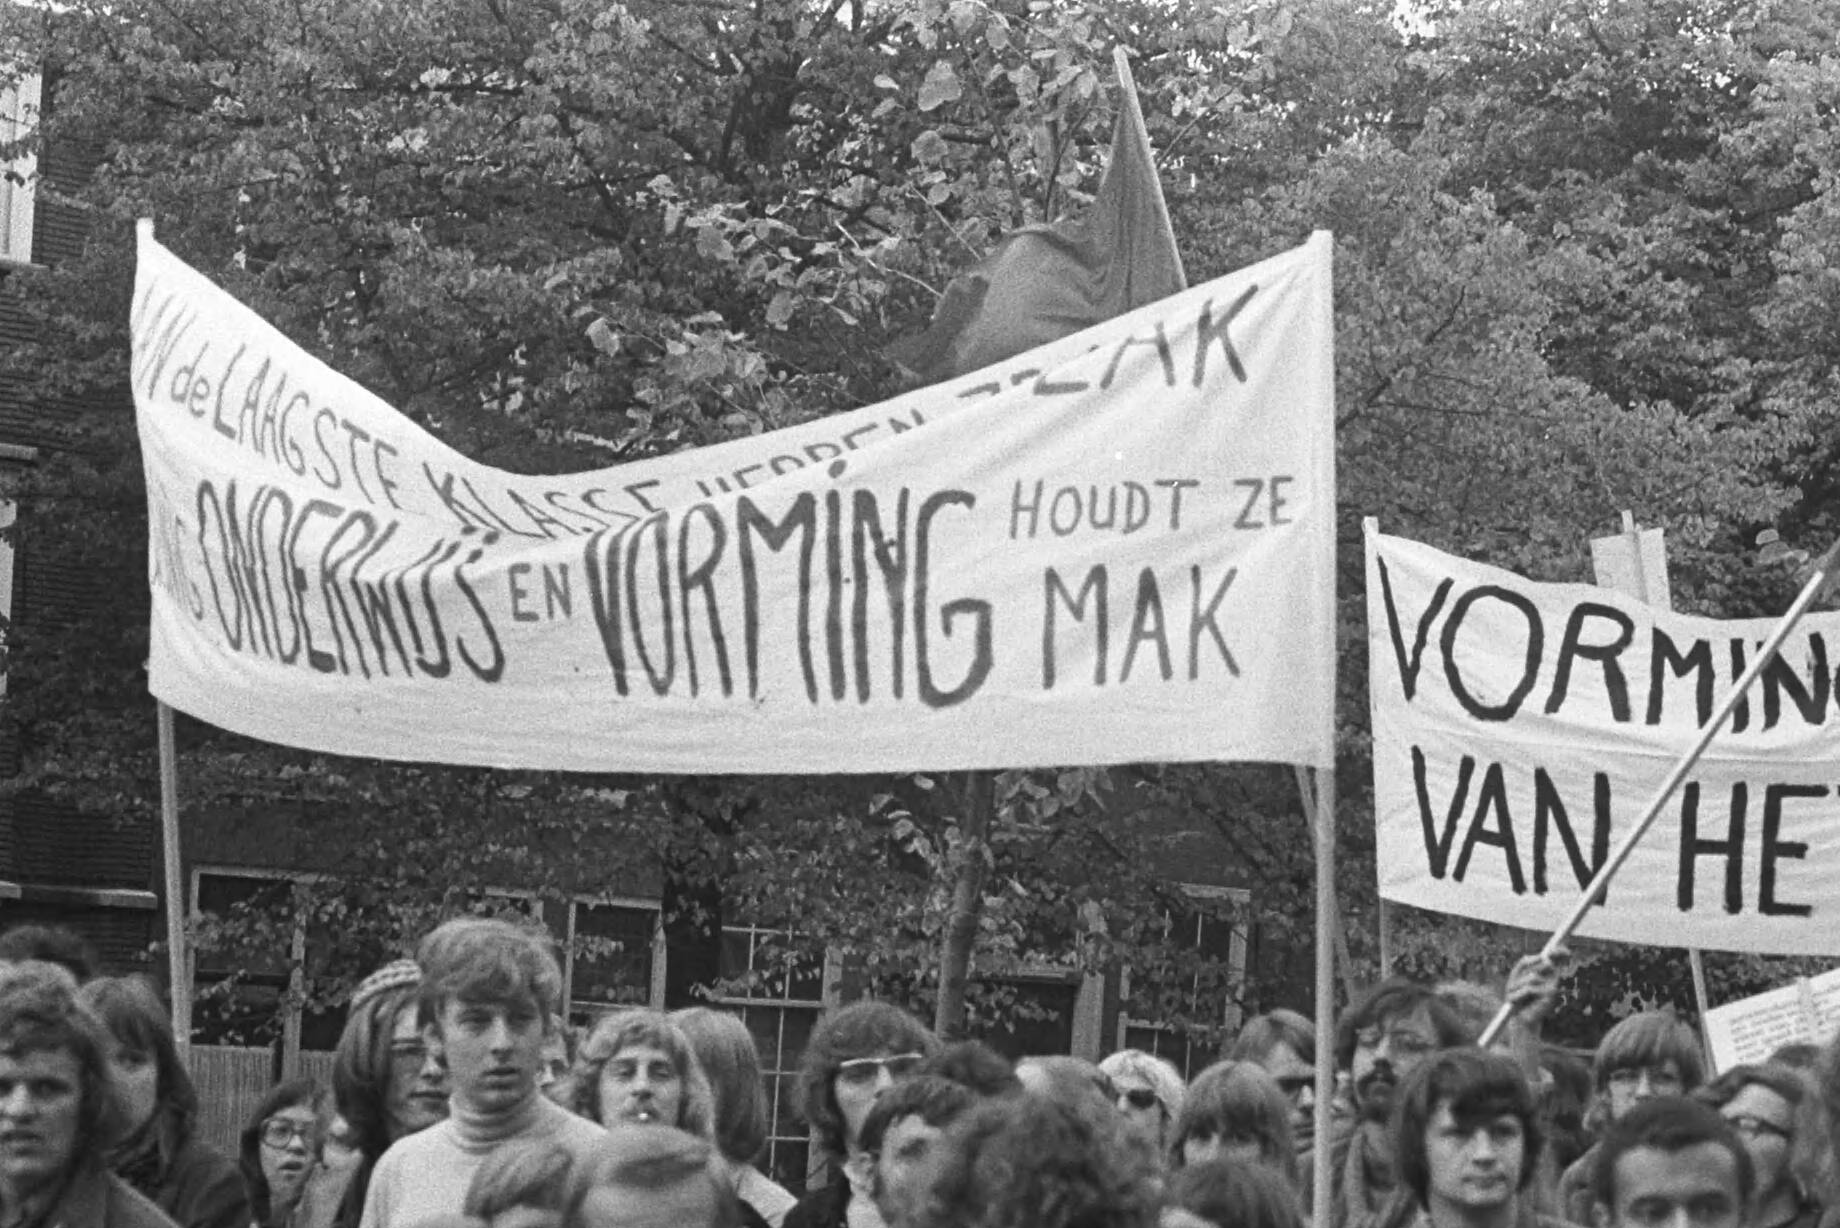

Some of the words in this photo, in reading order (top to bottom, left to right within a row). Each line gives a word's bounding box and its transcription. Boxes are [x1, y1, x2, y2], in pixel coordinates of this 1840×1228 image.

[170, 340, 211, 418] de
[507, 562, 573, 623] EN
[1009, 478, 1202, 540] HOUDT
[1233, 475, 1294, 531] ZE
[1042, 562, 1241, 691] MAK
[1411, 744, 1613, 907] VAN
